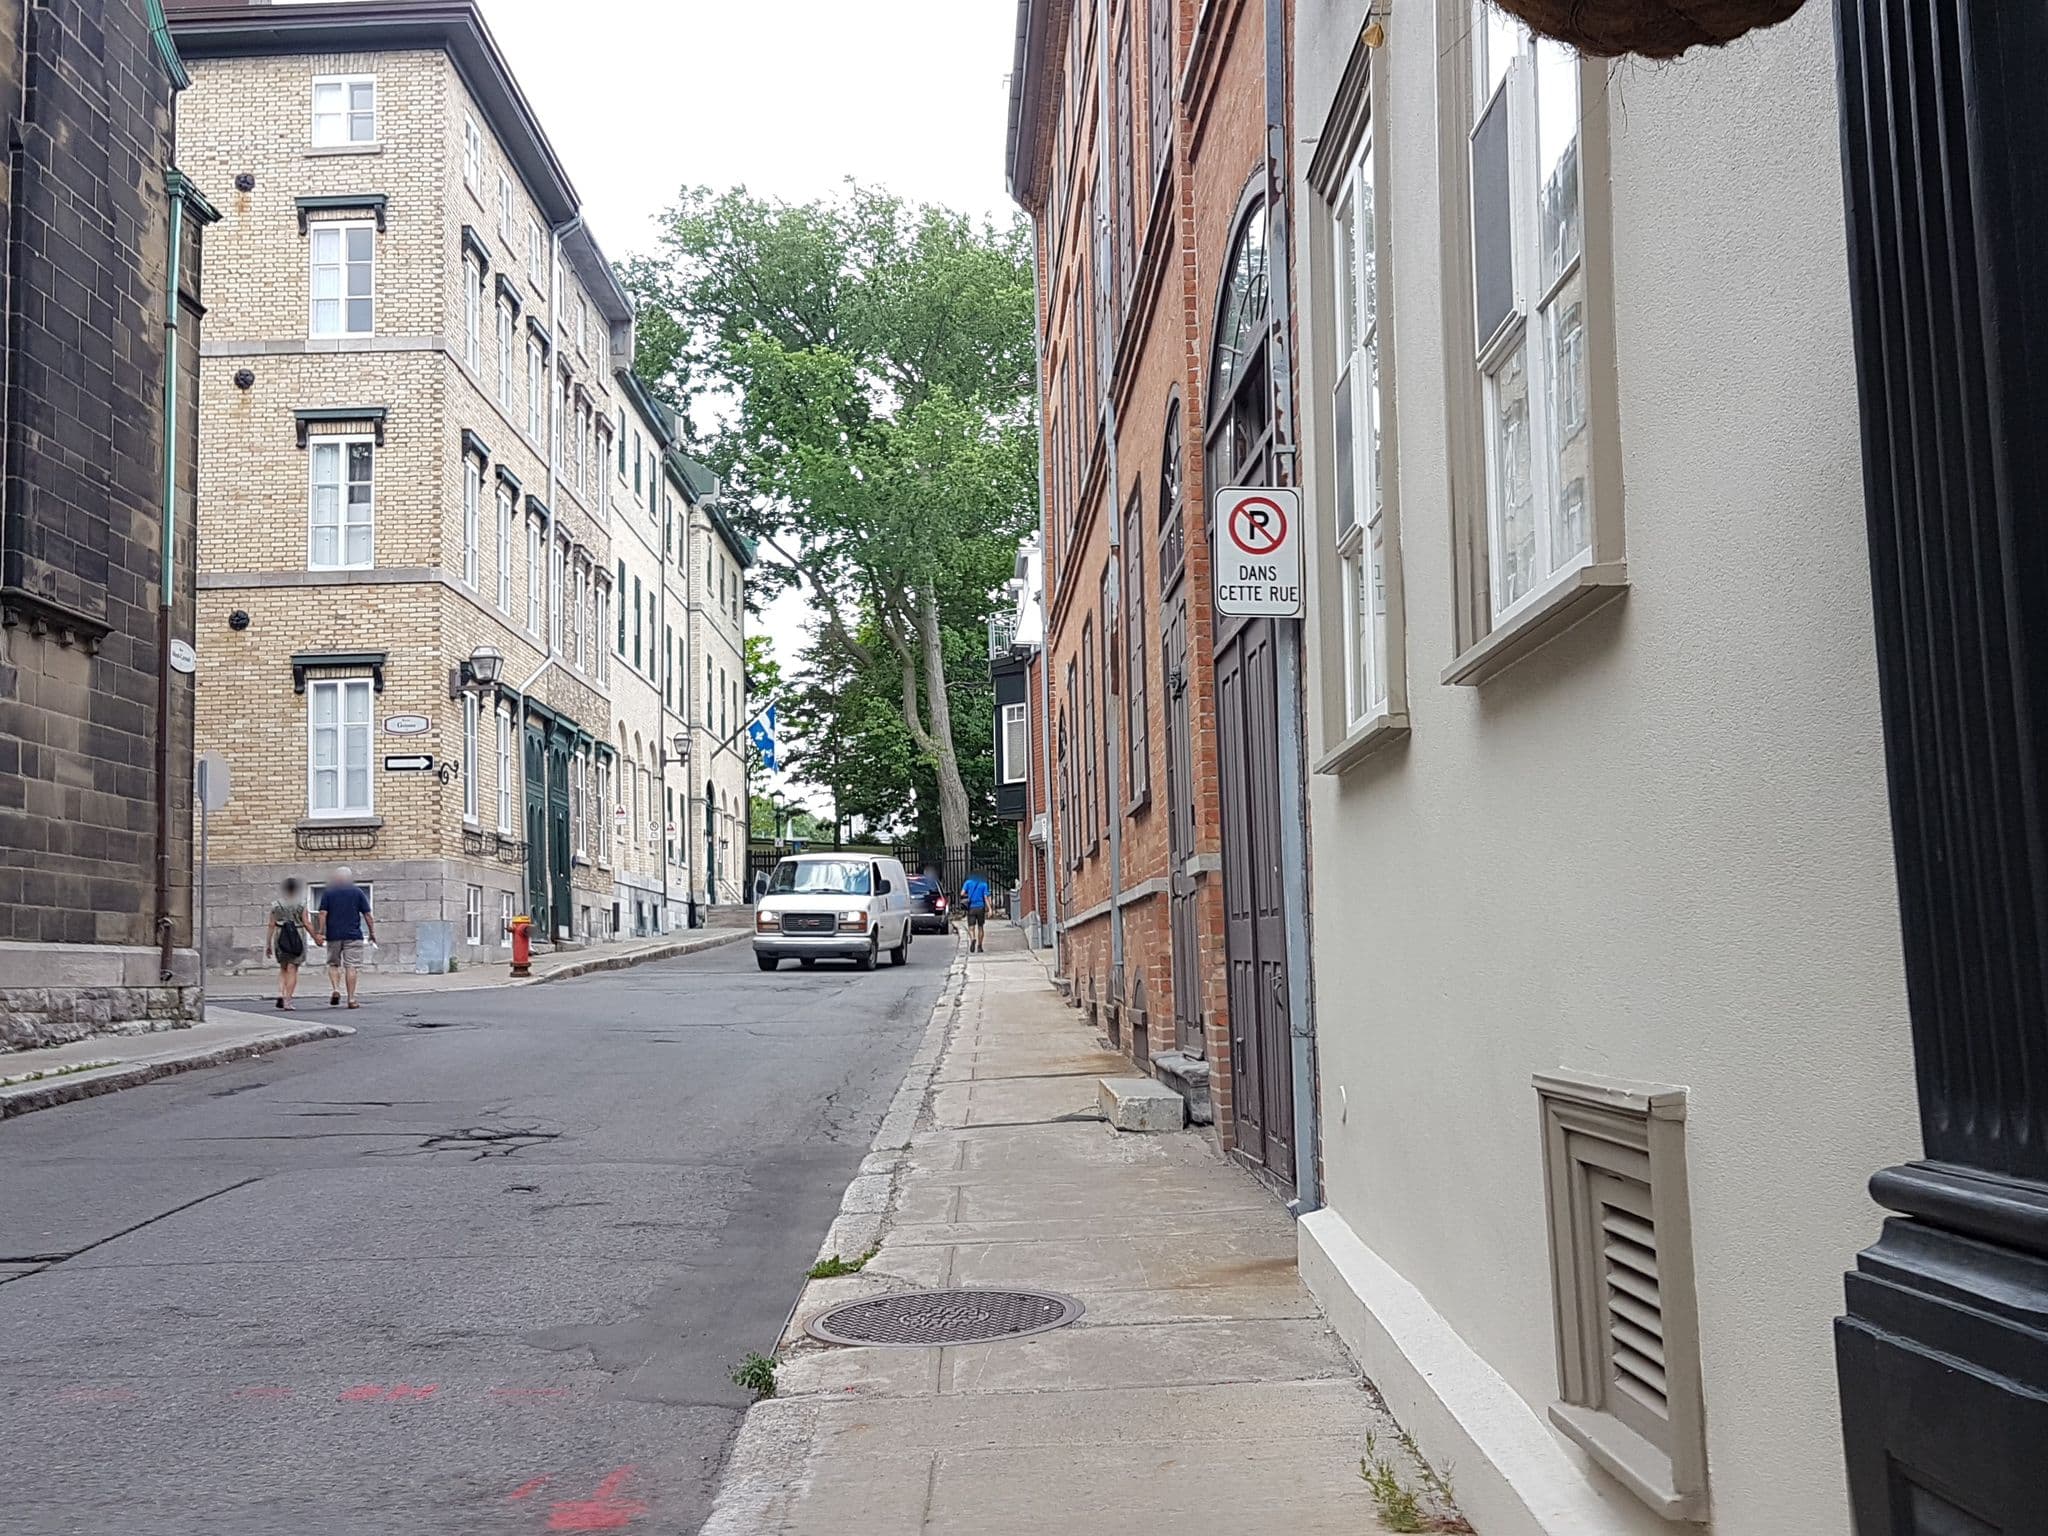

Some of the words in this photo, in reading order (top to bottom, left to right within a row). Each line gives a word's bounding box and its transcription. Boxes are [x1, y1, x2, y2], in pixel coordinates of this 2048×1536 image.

[1239, 565, 1277, 581] DANS
[1219, 585, 1262, 601] CETTE
[1270, 586, 1298, 602] RUE
